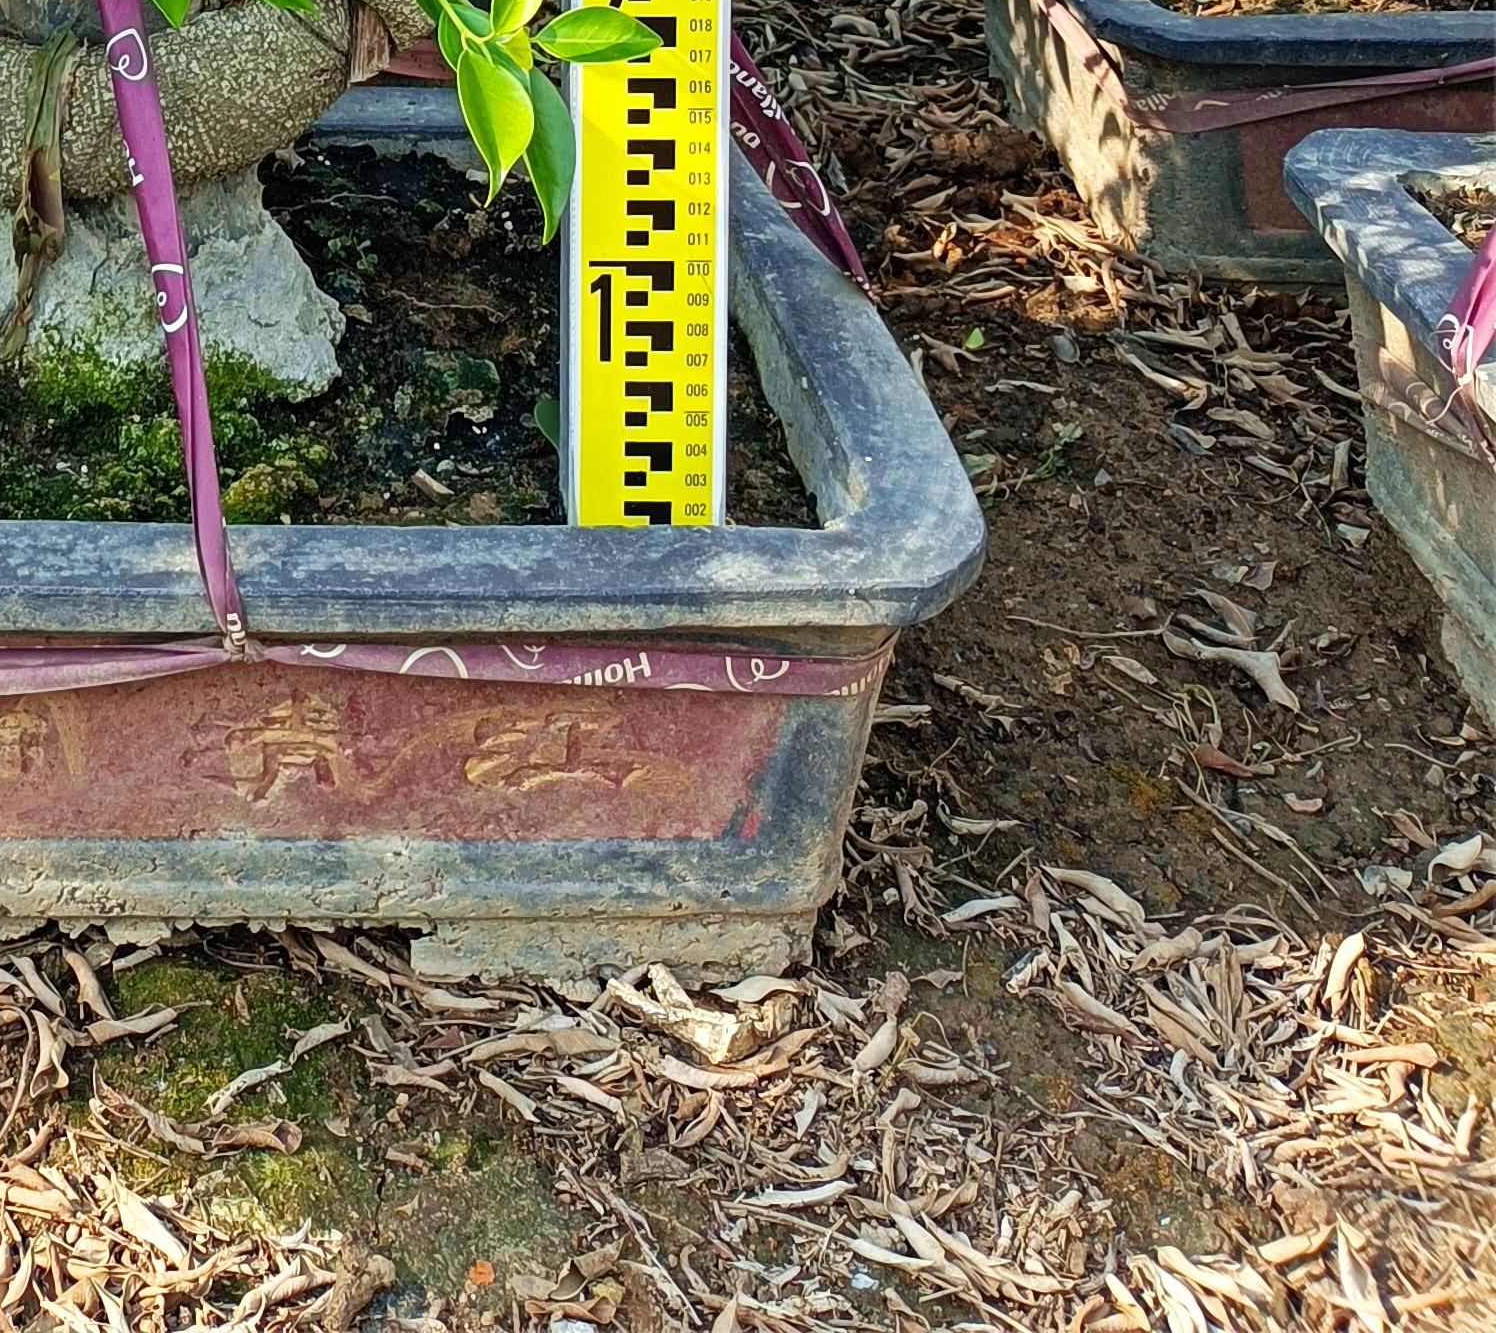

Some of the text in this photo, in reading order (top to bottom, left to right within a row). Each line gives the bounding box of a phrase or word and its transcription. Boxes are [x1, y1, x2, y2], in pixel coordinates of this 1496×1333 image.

[689, 18, 713, 33] 018
[689, 49, 712, 63] 017
[689, 79, 712, 94] 016
[689, 110, 712, 125] 015
[688, 141, 711, 155] 014
[688, 171, 711, 186] 013
[687, 201, 711, 216] 012
[687, 232, 709, 246] 011
[687, 262, 710, 277] 010
[686, 292, 710, 307] 009
[590, 274, 611, 361] 1
[686, 322, 709, 337] 008
[686, 353, 709, 367] 007
[685, 383, 709, 398] 006
[685, 413, 708, 428] 005
[685, 443, 708, 457] 004
[684, 473, 707, 487] 003
[684, 502, 707, 517] 002
